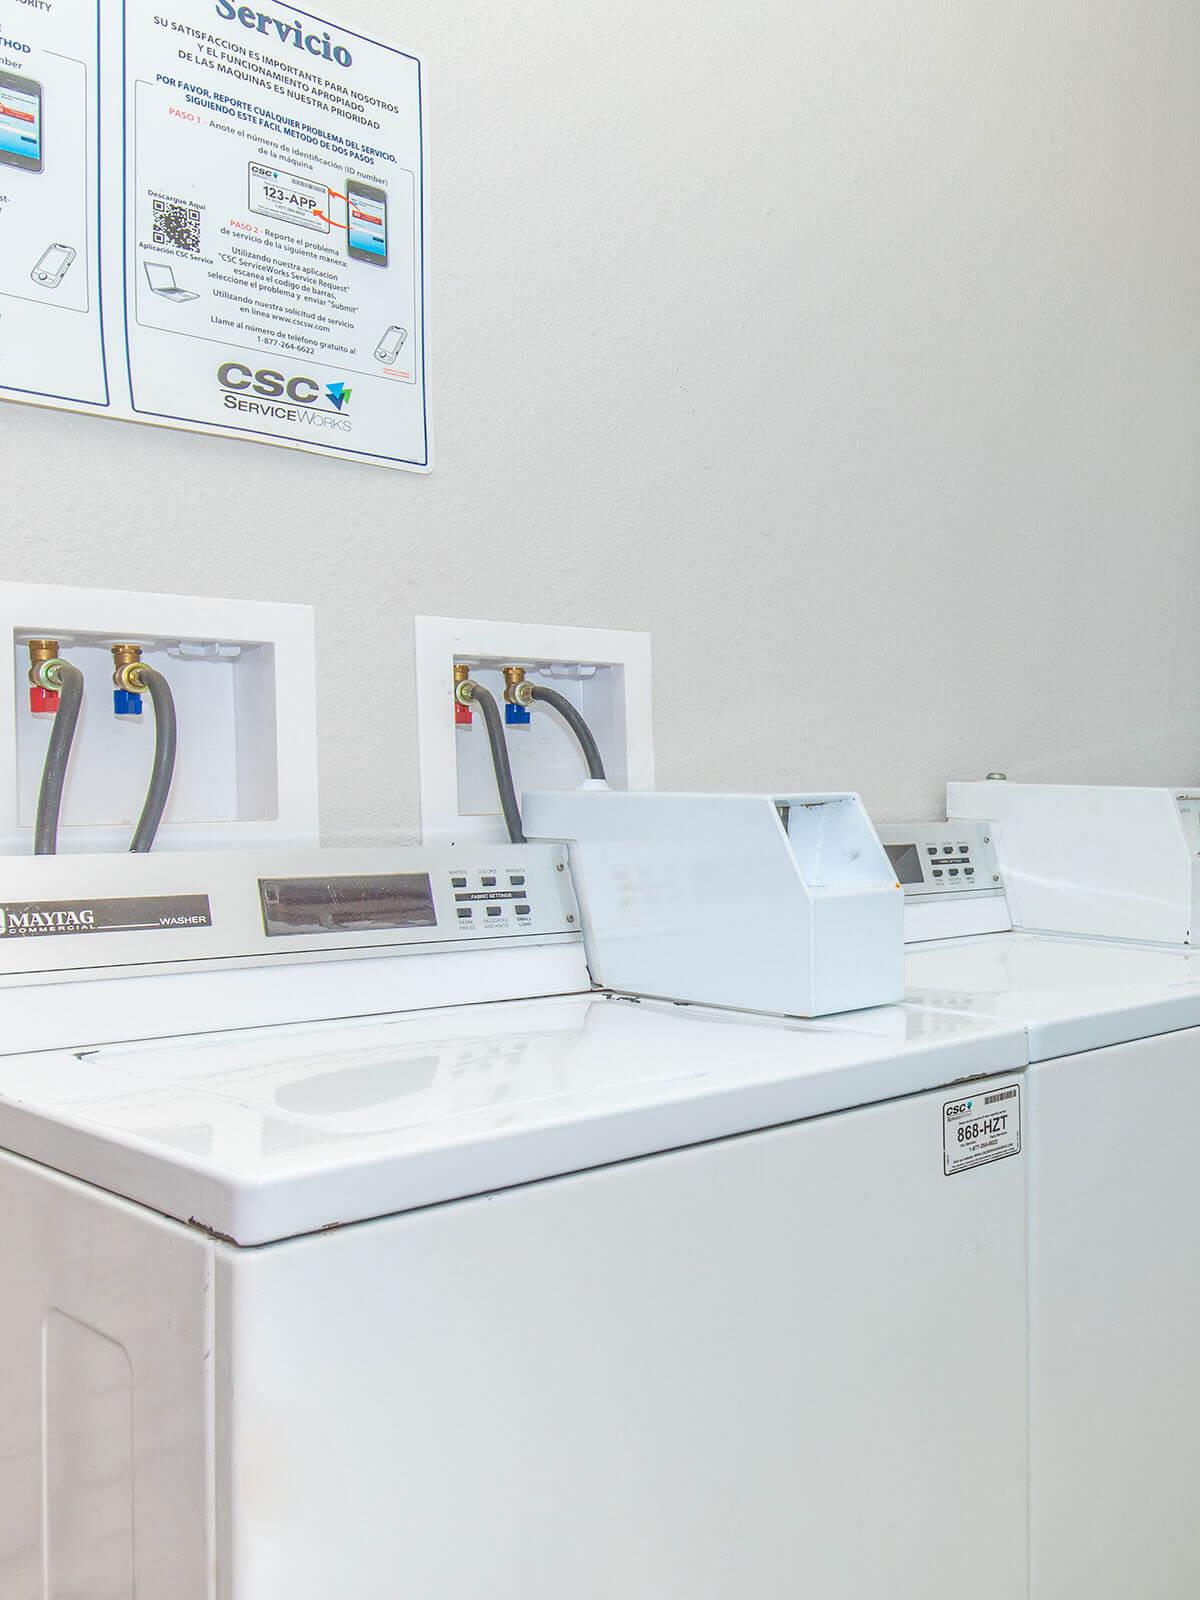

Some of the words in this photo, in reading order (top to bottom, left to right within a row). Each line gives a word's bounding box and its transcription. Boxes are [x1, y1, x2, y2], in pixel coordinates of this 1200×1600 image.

[216, 0, 352, 67] Servicio
[153, 16, 168, 27] SU
[171, 22, 247, 56] SATISFACCION
[249, 50, 260, 61] ES
[262, 56, 323, 85] IMPORTANTE
[324, 80, 349, 96] PARA
[351, 90, 400, 114] NOSOTROS
[197, 43, 204, 52] Y
[206, 47, 218, 58] EL
[220, 52, 310, 92] FUNCIONAMIENTO
[311, 87, 365, 113] APROPIADO
[178, 50, 192, 61] DE
[195, 56, 215, 69] LAS
[217, 64, 272, 90] MAQUINAS
[274, 84, 285, 95] ES
[287, 88, 330, 111] NUESTRA
[331, 106, 380, 130] PRIORIDAD
[156, 74, 176, 87] POR
[177, 81, 212, 99] FAVOR,
[213, 92, 252, 112] REPORTE
[254, 106, 301, 130] CUALQUIER
[302, 123, 344, 145] PROBLEMA
[345, 139, 360, 151] DEL
[361, 144, 398, 164] SERVICIO,
[185, 94, 236, 117] SIGUIENDO
[237, 111, 258, 124] ESTE
[259, 119, 282, 134] FACIL
[283, 127, 319, 145] METODO
[320, 140, 331, 150] DE
[331, 144, 348, 156] DOS
[350, 151, 375, 165] PASOS
[168, 107, 195, 122] PASO
[196, 116, 201, 124] 1
[209, 120, 236, 134] Anote
[237, 130, 245, 138] el
[247, 132, 279, 149] número
[280, 144, 290, 153] de
[344, 165, 355, 175] (ID
[357, 171, 388, 186] number)
[257, 146, 268, 155] de
[270, 149, 277, 159] la
[251, 166, 272, 177] CSC
[147, 189, 188, 206] Descargue
[263, 185, 317, 210] 123-APP
[220, 227, 231, 236] de
[232, 231, 262, 244] servicio
[263, 238, 274, 247] de
[275, 241, 282, 250] la
[283, 244, 318, 260] siguiente
[319, 254, 348, 268] manera:
[230, 220, 252, 232] PASO
[265, 229, 295, 244] Reporte
[296, 238, 303, 246] el
[304, 241, 340, 256] problema
[175, 248, 189, 259] CSC
[190, 253, 214, 265] Service
[231, 247, 272, 263] Utilizando
[272, 258, 301, 271] nuestra
[207, 270, 249, 287] seleccione
[250, 281, 257, 289] el
[258, 283, 295, 299] problema
[304, 296, 326, 306] enviar
[328, 300, 359, 314] "Submit"
[233, 268, 265, 281] escanea
[266, 275, 273, 283] el
[301, 284, 311, 293] de
[238, 257, 290, 278] ServiceWorks
[291, 271, 318, 285] Service
[318, 279, 350, 293] Request"
[212, 288, 253, 305] Utilizando
[254, 299, 283, 312] nuestra
[284, 306, 316, 320] solicitud
[316, 313, 327, 322] de
[327, 317, 355, 329] servicio
[271, 314, 331, 332] www.cscsw.com
[210, 315, 235, 327] Llame
[236, 321, 244, 329] al
[245, 323, 276, 337] número
[276, 331, 287, 340] de
[319, 340, 349, 353] gratuito
[350, 347, 356, 355] al
[257, 335, 315, 355] 1-877-264-6622
[217, 362, 320, 404] CSC
[8, 910, 95, 928] MAYTAG
[8, 924, 96, 935] COMMERCIAL
[159, 915, 207, 926] WASHER
[946, 1103, 967, 1116] CSC
[957, 1114, 1008, 1142] 868-HZT
